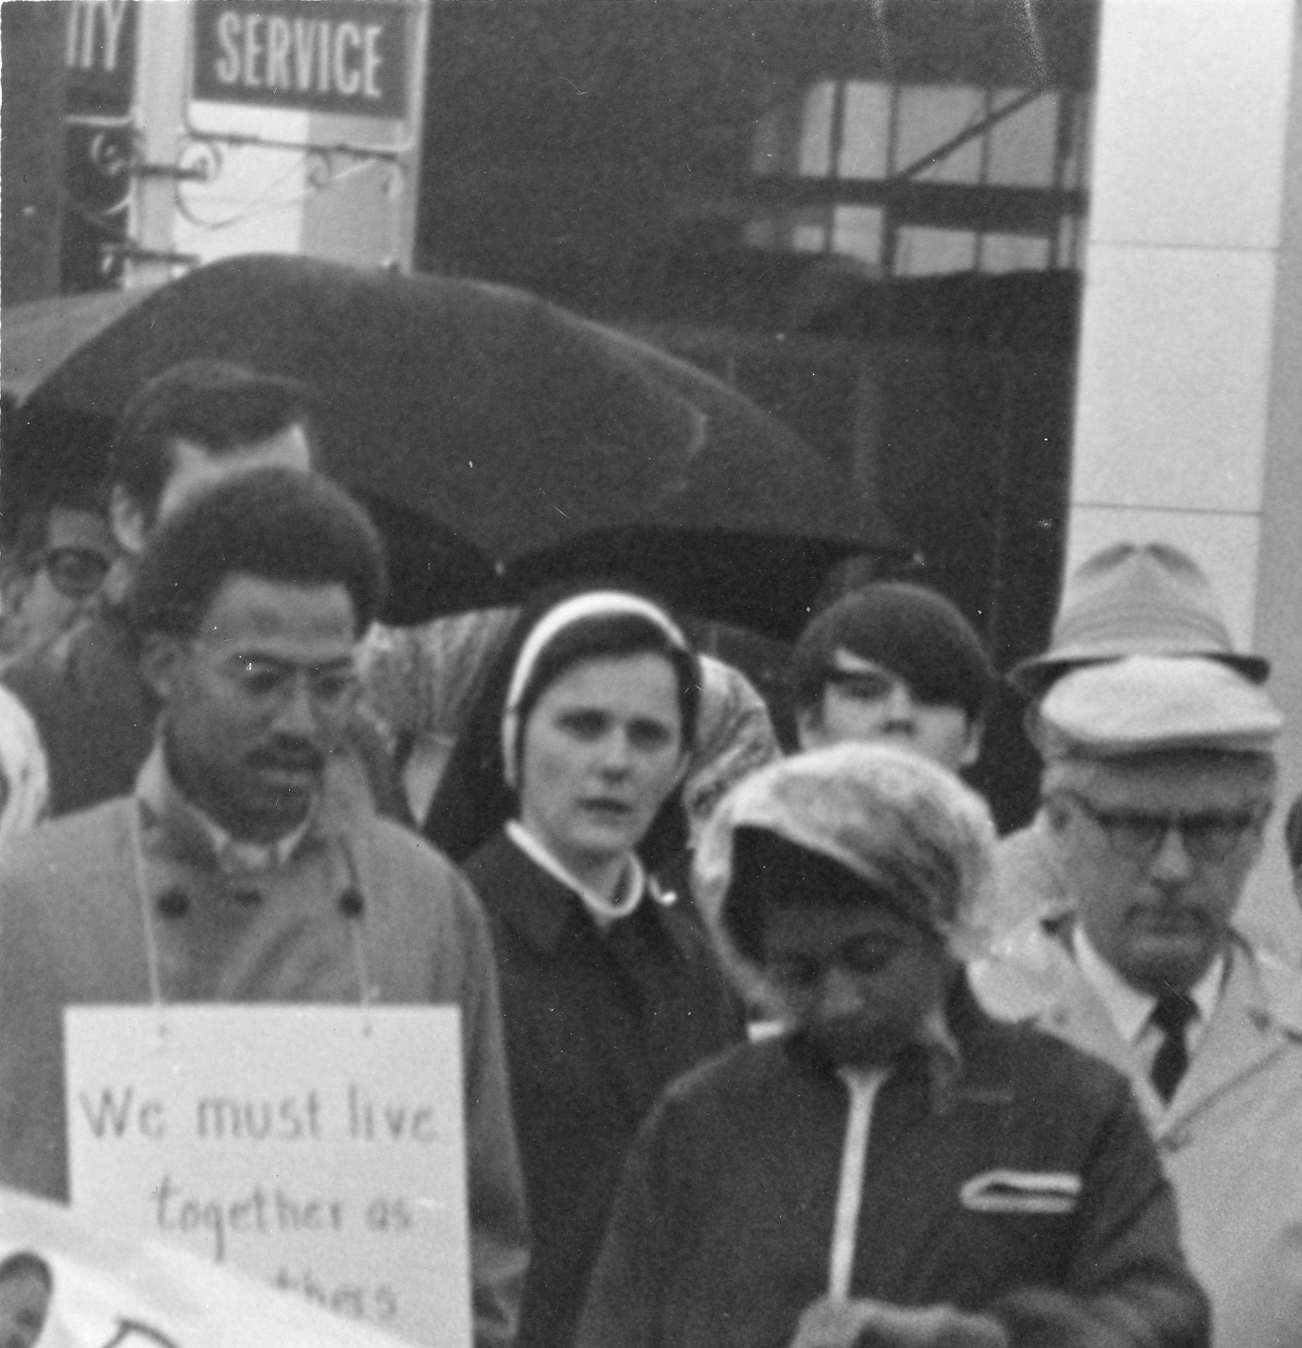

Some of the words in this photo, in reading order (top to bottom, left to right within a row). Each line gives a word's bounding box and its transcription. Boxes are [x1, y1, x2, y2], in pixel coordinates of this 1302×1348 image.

[215, 11, 386, 98] SERVICE
[80, 1086, 166, 1140] We
[199, 1091, 323, 1139] must
[348, 1085, 439, 1142] live
[154, 1176, 343, 1262] together
[367, 1196, 414, 1231] as
